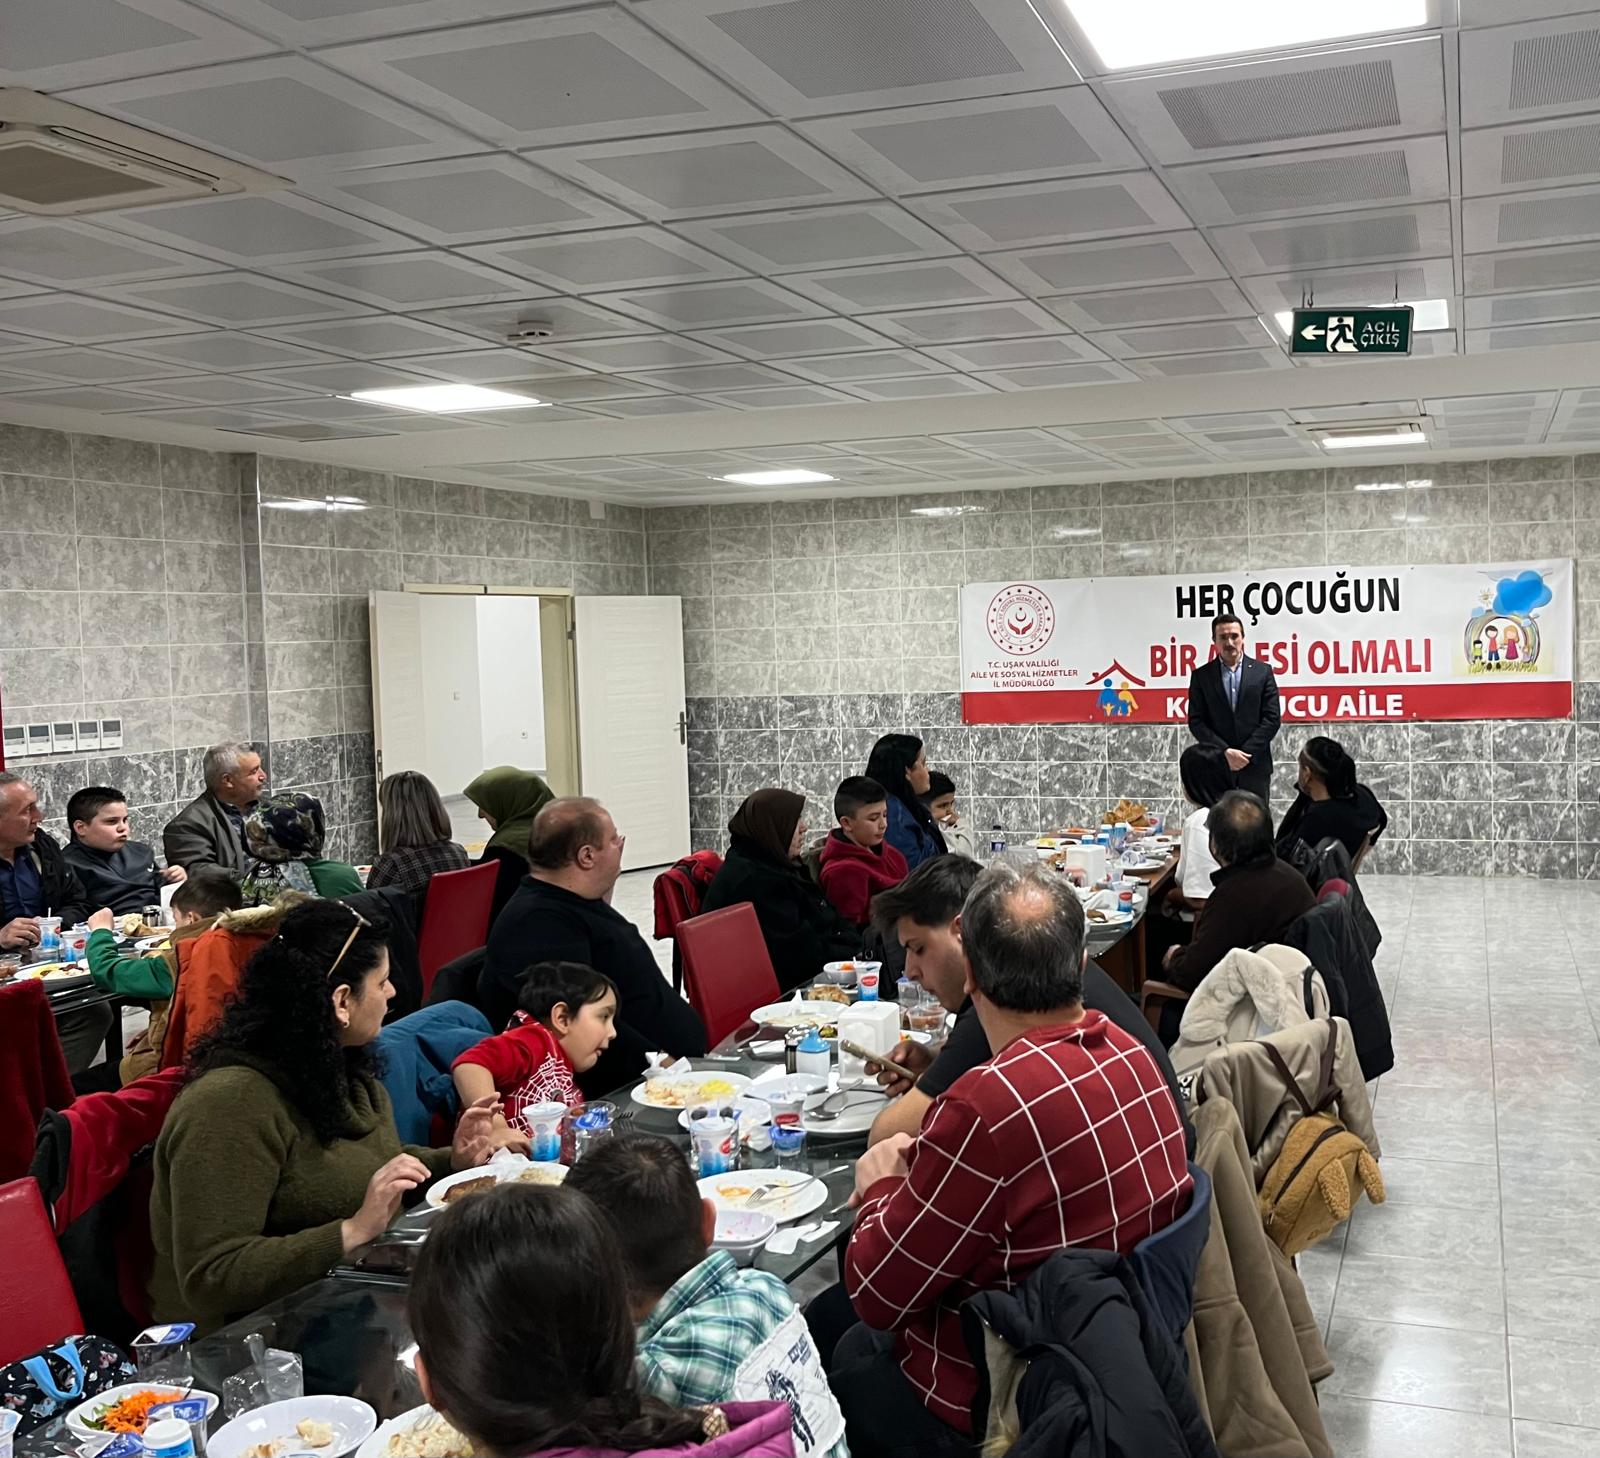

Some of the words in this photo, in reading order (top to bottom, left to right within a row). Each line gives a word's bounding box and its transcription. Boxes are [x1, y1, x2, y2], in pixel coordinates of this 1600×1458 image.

[1360, 333, 1400, 348] ÇIKIŞ
[1176, 584, 1235, 618] HER
[1243, 571, 1400, 626] ÇOCUĞUN
[1150, 636, 1198, 677] BİR
[1308, 638, 1432, 675] OLMALI
[1003, 661, 1024, 670] UŞAK
[970, 671, 987, 679] AİLE
[1001, 670, 1031, 678] SOSYAL
[1032, 669, 1078, 678] HİZMETLER
[1002, 678, 1055, 688] MÜDÜRLÜĞÜ
[1335, 689, 1404, 717] AİLE
